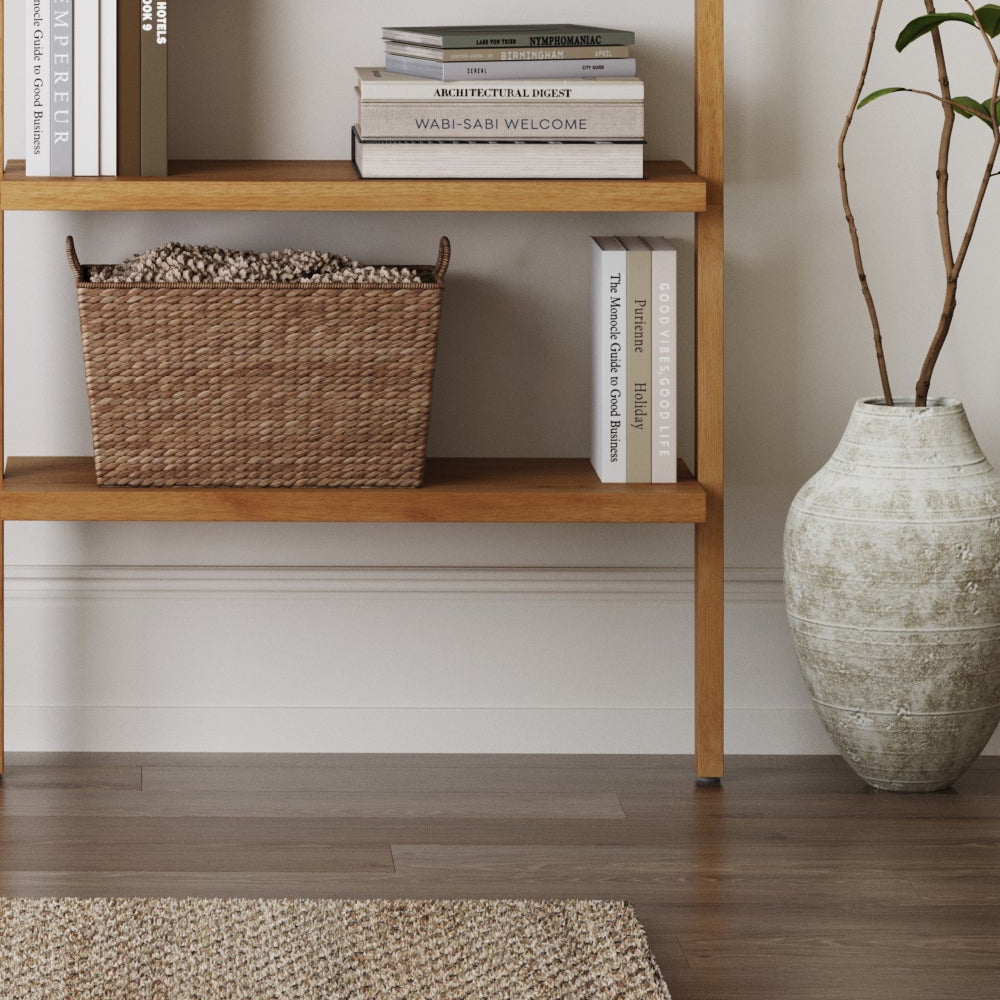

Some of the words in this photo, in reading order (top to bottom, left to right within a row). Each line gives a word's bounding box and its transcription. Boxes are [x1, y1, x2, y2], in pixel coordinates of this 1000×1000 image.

[142, 23, 153, 32] 9
[156, 1, 167, 44] HOTELS
[33, 29, 44, 61] Guide
[501, 50, 564, 60] BIRMINGHAM
[529, 35, 602, 46] NYMPHOMANIAC
[33, 65, 41, 75] to
[33, 78, 44, 107] Good
[433, 88, 530, 98] ARCHITECTURAL
[532, 88, 573, 98] DIGEST
[33, 110, 44, 155] Business
[415, 118, 499, 130] WABI-SABI
[504, 118, 588, 130] WELCOME
[610, 273, 621, 294] The
[610, 296, 621, 340] Monocle
[659, 283, 670, 325] GOOD
[634, 299, 647, 353] Purienne
[610, 342, 621, 373] Guide
[657, 329, 670, 375] VIBES,
[610, 376, 618, 386] to
[610, 388, 621, 417] Good
[631, 382, 648, 431] Holiday
[659, 378, 670, 420] GOOD
[610, 420, 621, 463] Business
[659, 425, 670, 457] LIFE
